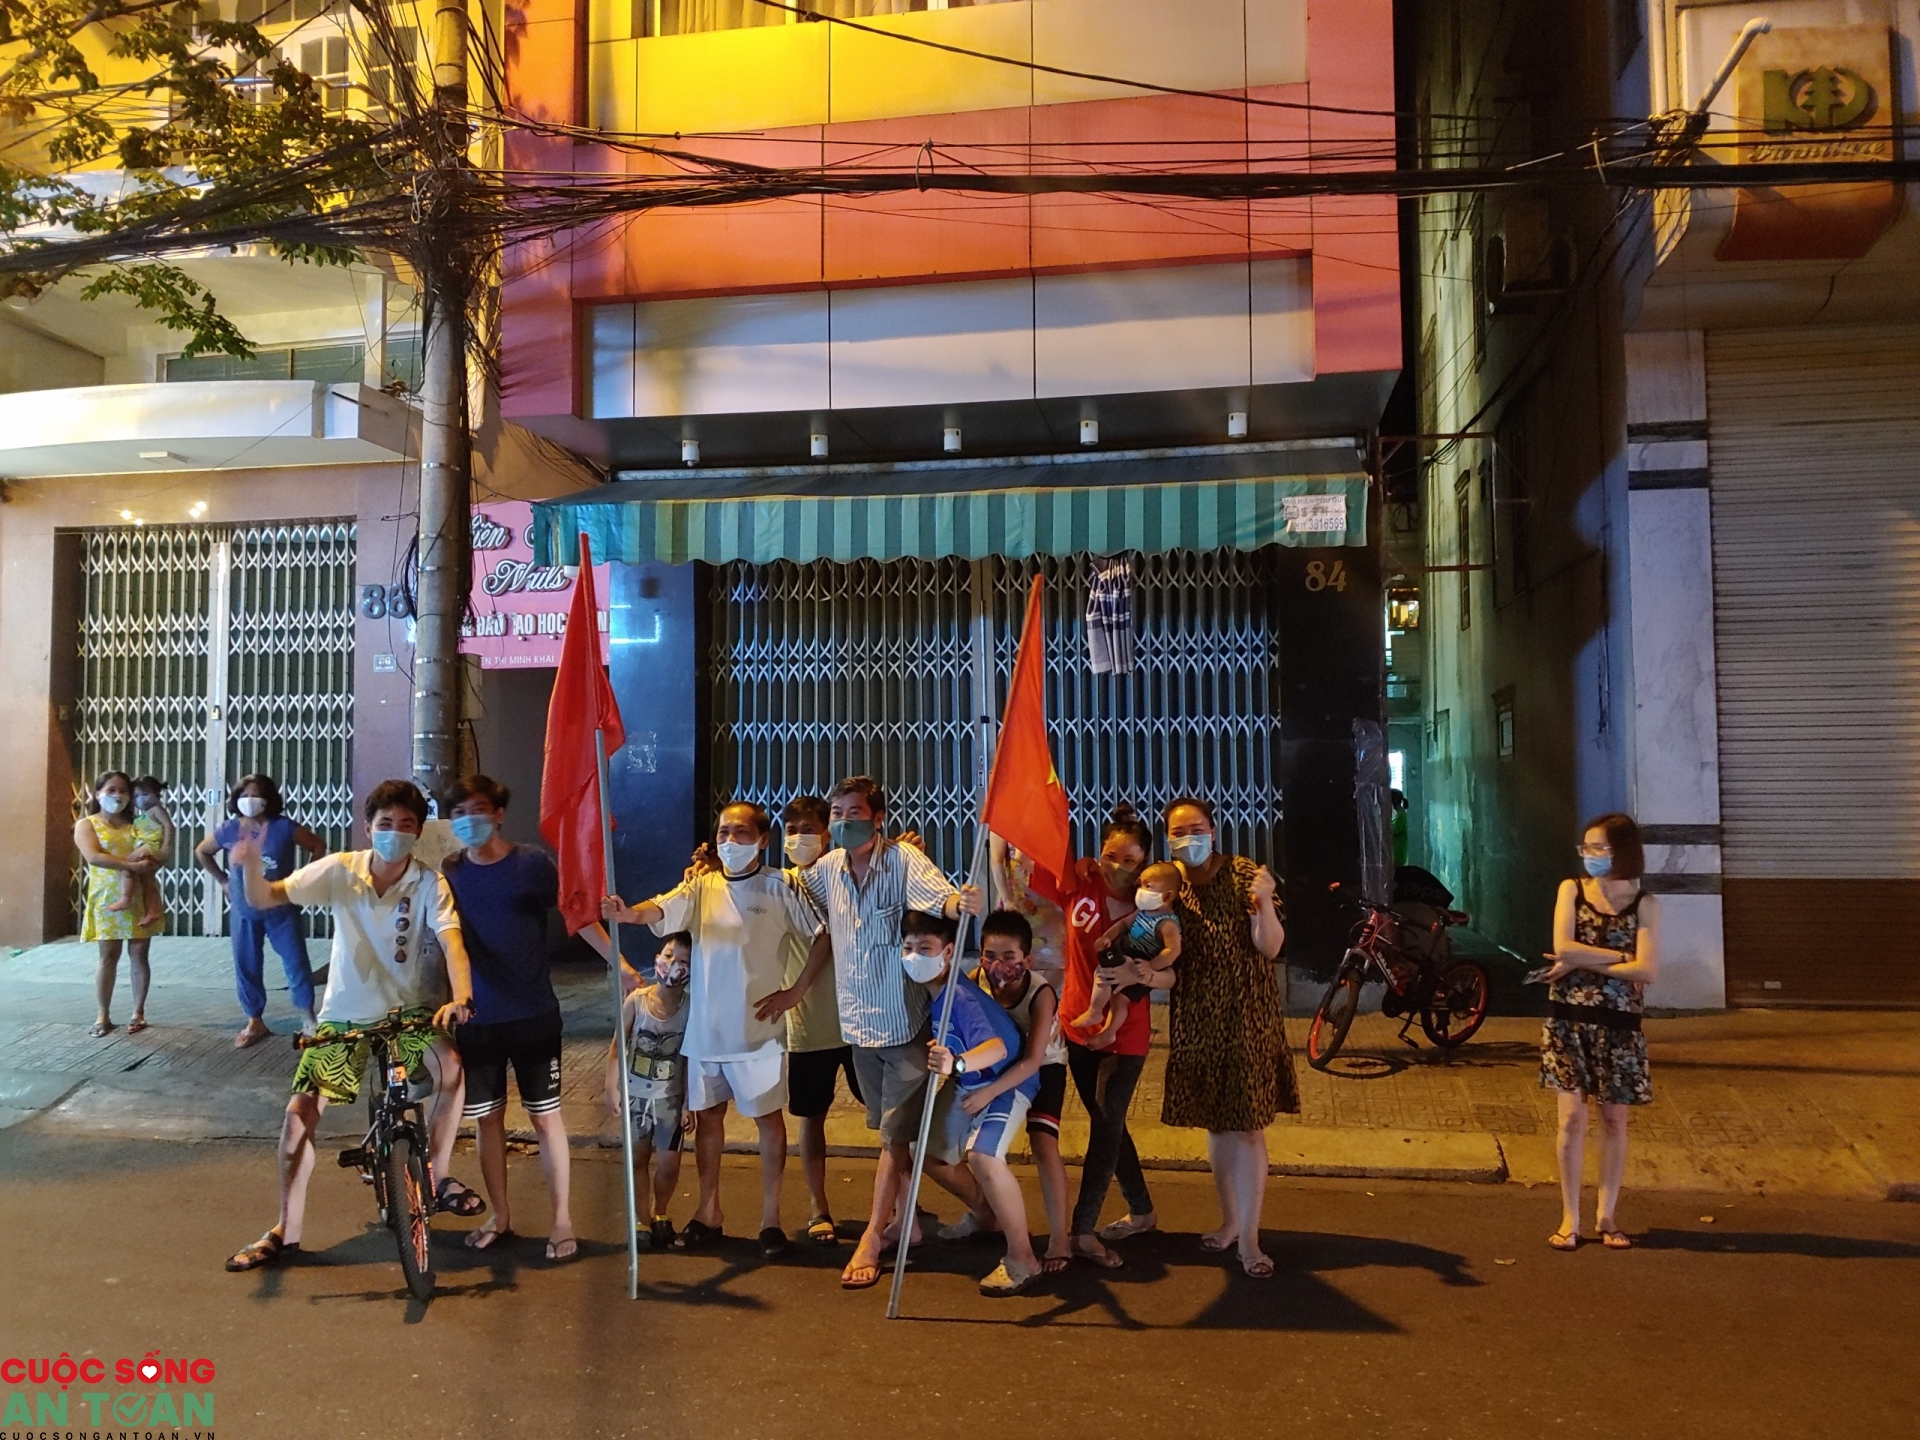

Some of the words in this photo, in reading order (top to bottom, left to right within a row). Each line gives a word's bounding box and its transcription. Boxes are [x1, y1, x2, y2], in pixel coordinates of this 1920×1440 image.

[1305, 560, 1347, 592] 84
[362, 585, 410, 619] 86
[537, 613, 567, 640] HỌC
[509, 655, 532, 664] MINH
[534, 654, 555, 664] KHAI
